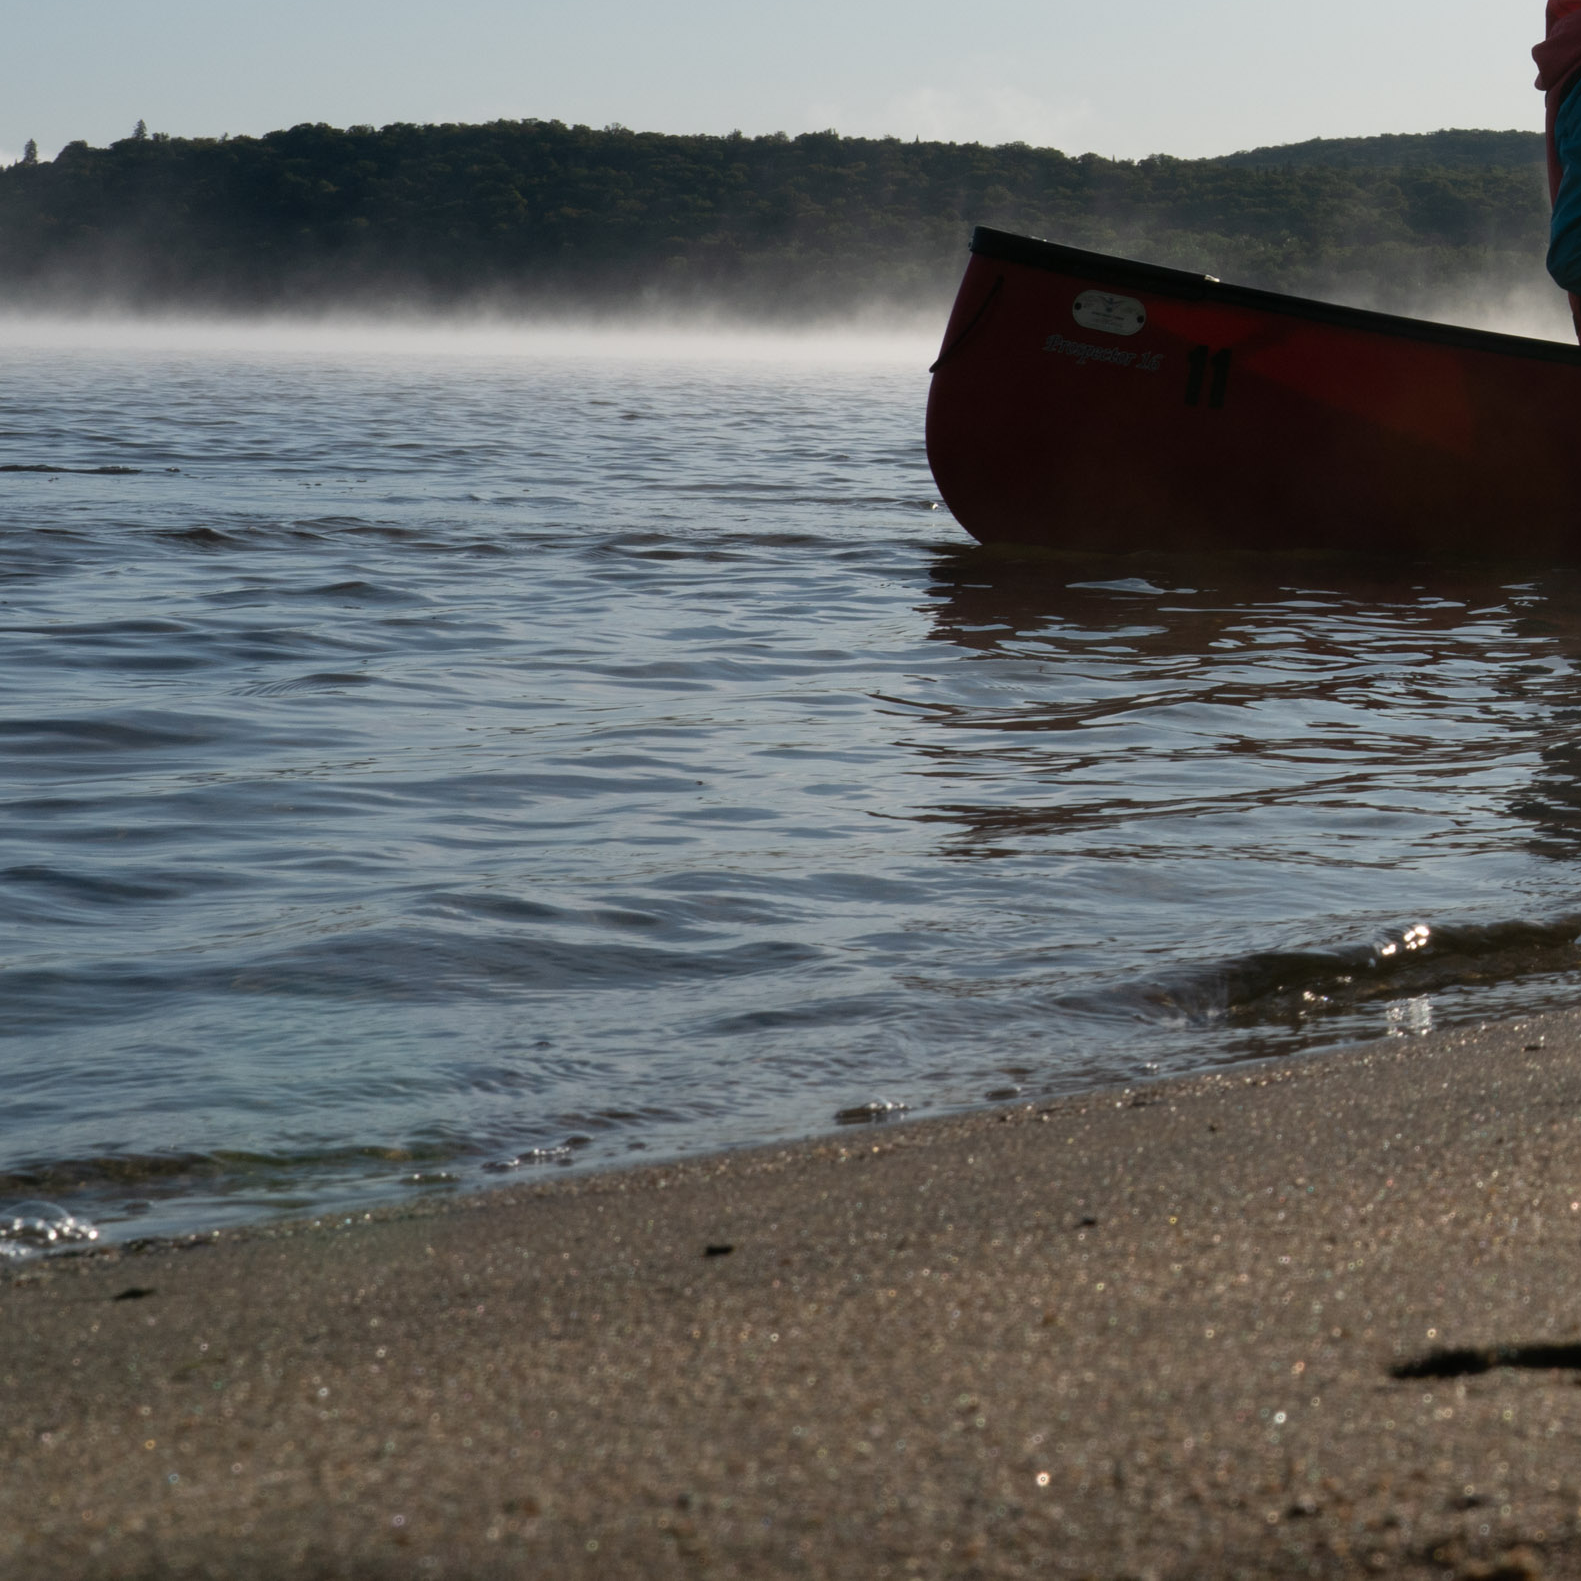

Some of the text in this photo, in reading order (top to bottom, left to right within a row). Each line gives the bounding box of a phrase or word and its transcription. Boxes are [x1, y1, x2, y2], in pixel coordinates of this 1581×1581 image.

[1042, 335, 1165, 372] Prospector 16
[1184, 345, 1233, 409] 11
